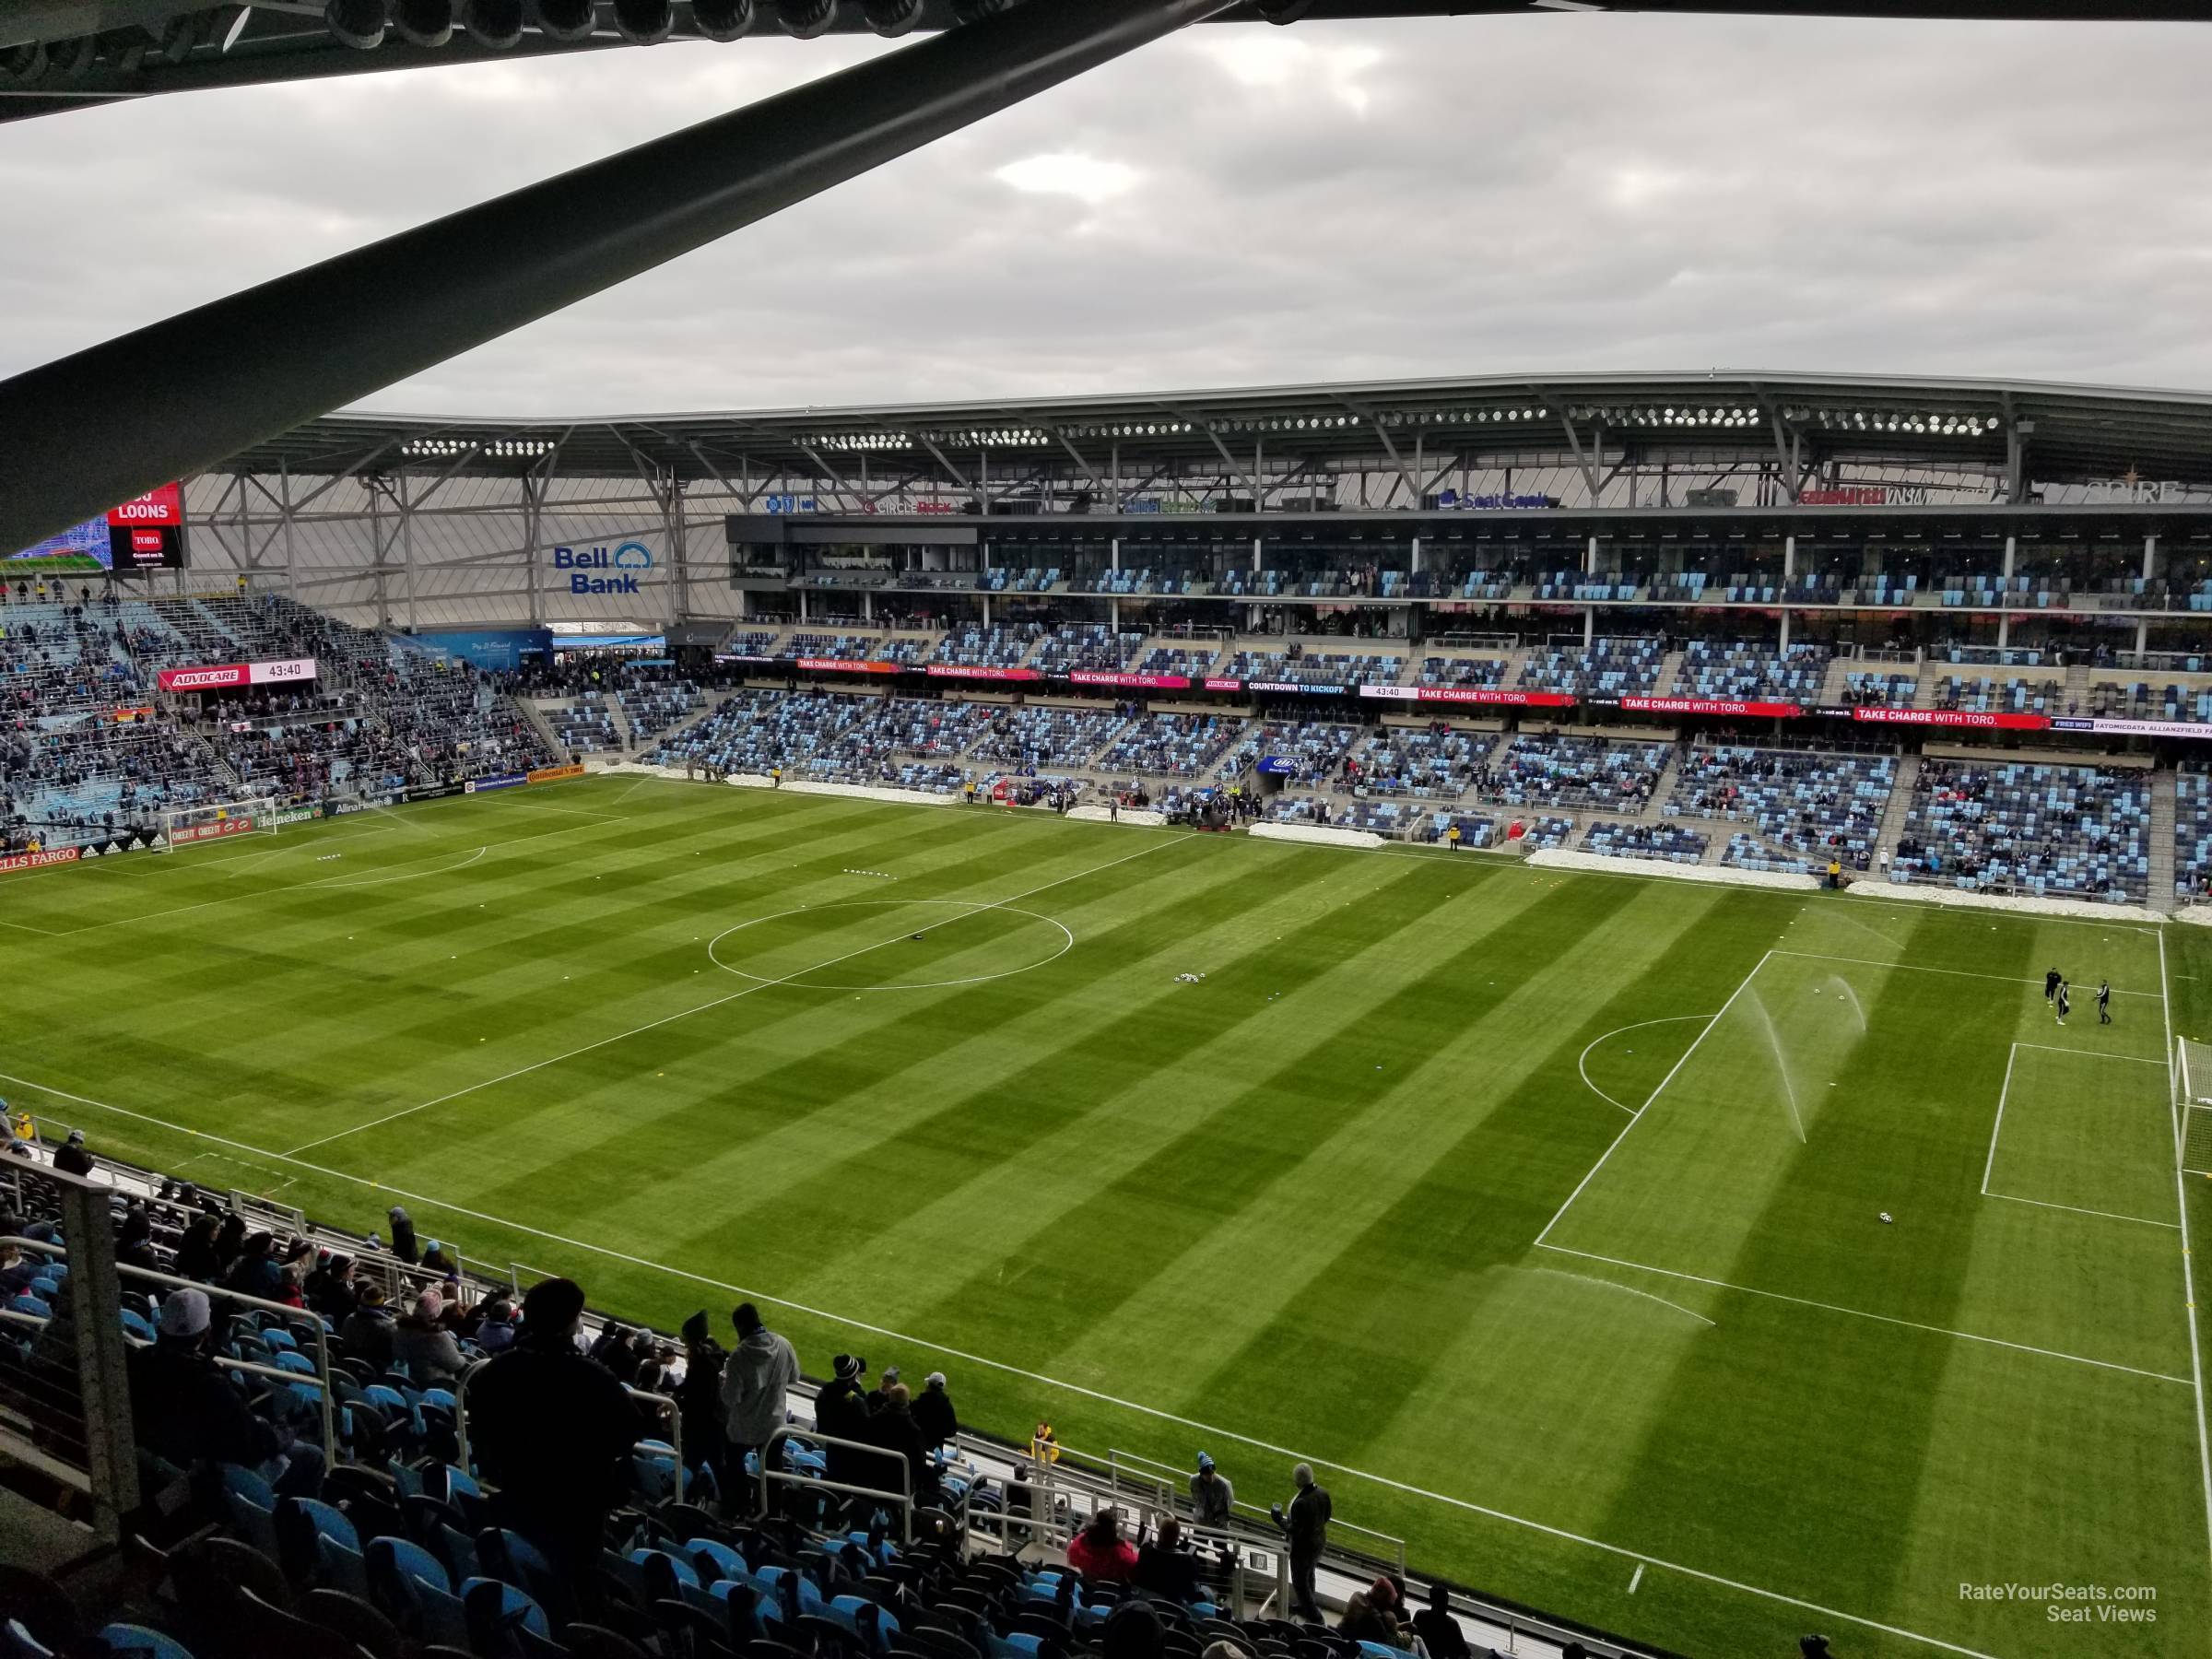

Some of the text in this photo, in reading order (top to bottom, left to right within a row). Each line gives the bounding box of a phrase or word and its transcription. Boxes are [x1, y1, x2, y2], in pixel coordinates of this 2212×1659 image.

[118, 504, 168, 518] LOONS
[554, 547, 608, 569] Bell
[571, 573, 640, 594] Bank
[799, 659, 814, 667] TAKE
[269, 664, 300, 677] 43:40
[946, 667, 971, 676] CHARGE
[971, 668, 987, 677] WITH
[988, 669, 1006, 677] TORO.
[173, 670, 239, 686] ADVOCARE
[1091, 675, 1118, 683] CHARGE
[1248, 682, 1298, 691] COUNTDOWN
[1311, 685, 1345, 693] KICKOFF
[1376, 688, 1399, 696] 43:40
[1420, 689, 1528, 702] TAKE CHARGE WITH TORO.
[1625, 699, 1748, 712] TAKE CHARGE WITH TORO.
[1858, 709, 1997, 724] TAKE CHARGE WITH TORO.
[2095, 723, 2146, 731] #ATOMICDATA
[2148, 725, 2202, 734] ALLIANZFIELD
[529, 766, 583, 782] Continental TIRE
[335, 796, 383, 814] Allina Health
[257, 811, 312, 828] Heneken
[31, 848, 76, 864] FARGO
